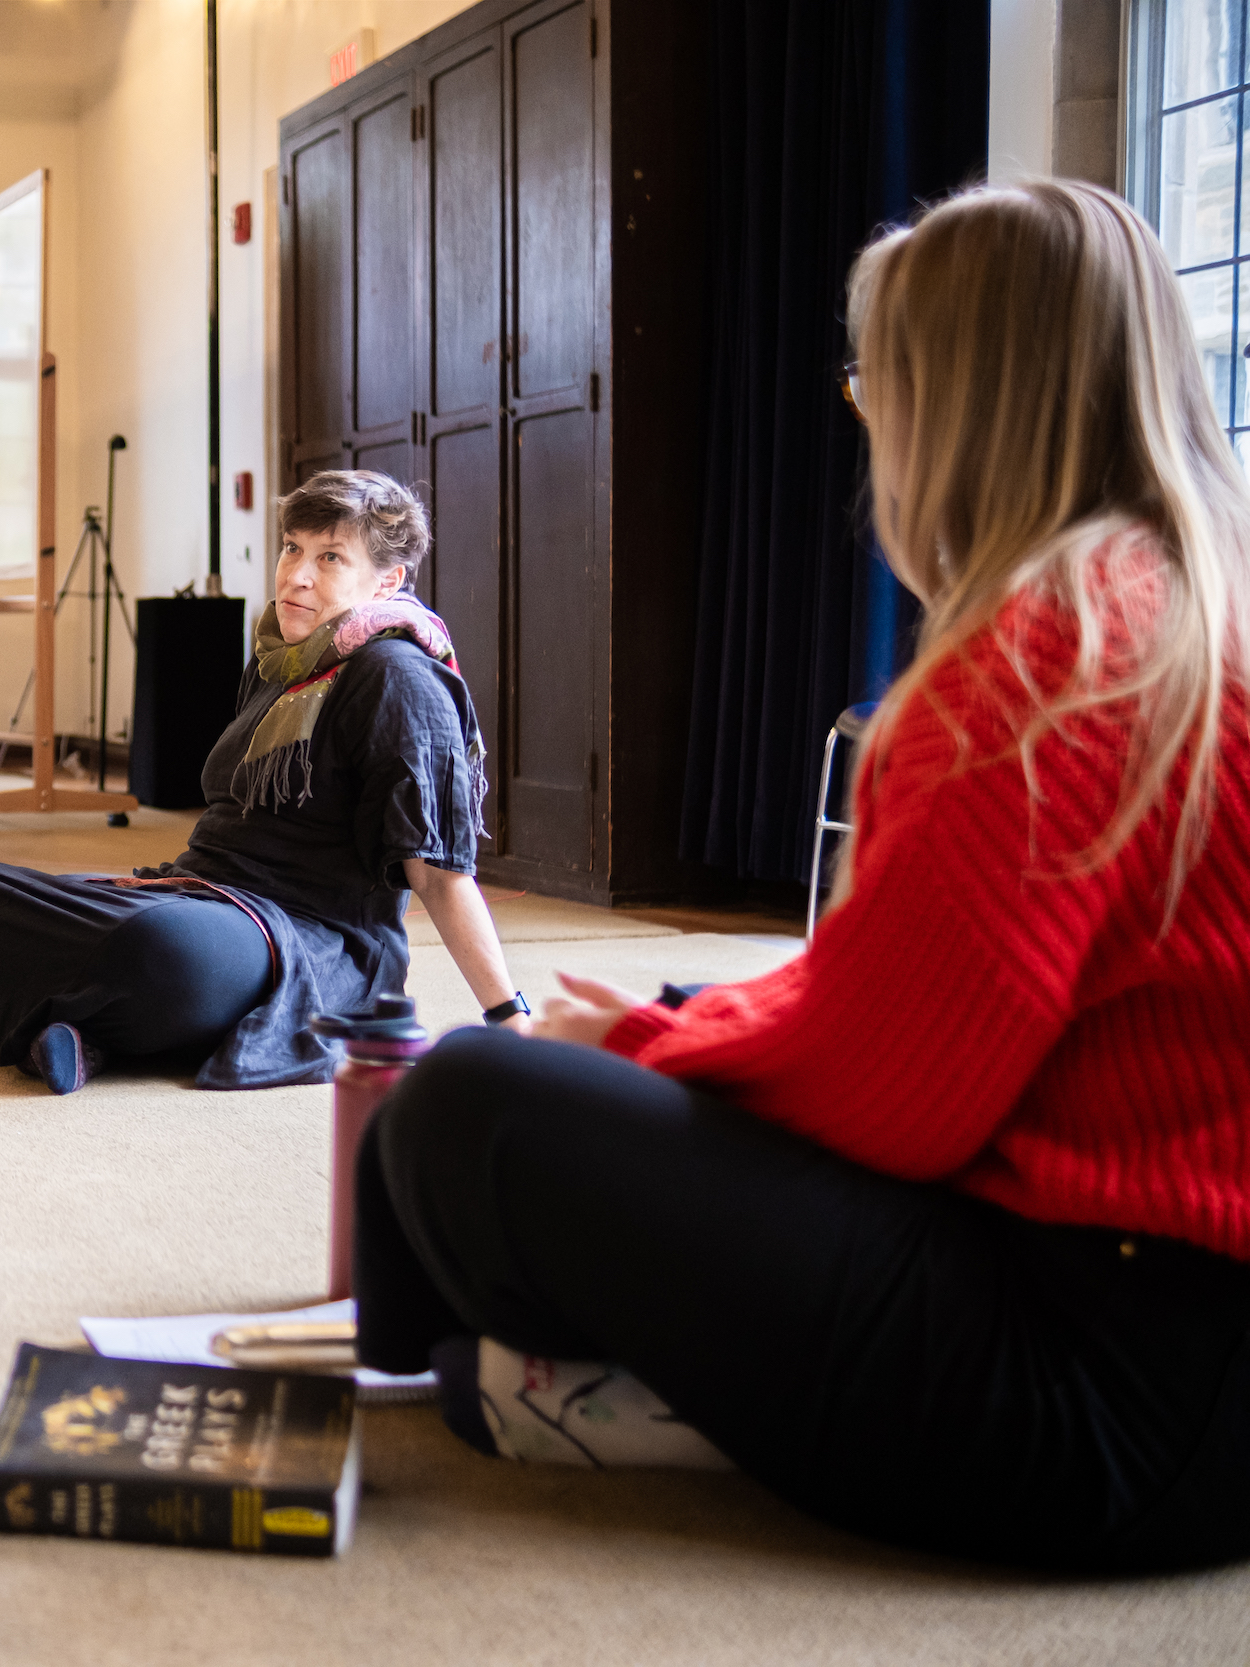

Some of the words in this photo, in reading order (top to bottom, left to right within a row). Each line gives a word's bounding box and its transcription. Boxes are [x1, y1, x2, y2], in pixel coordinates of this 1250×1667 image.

[330, 42, 358, 87] EXIT
[141, 1382, 199, 1470] GREEK
[188, 1387, 246, 1474] PLAYS
